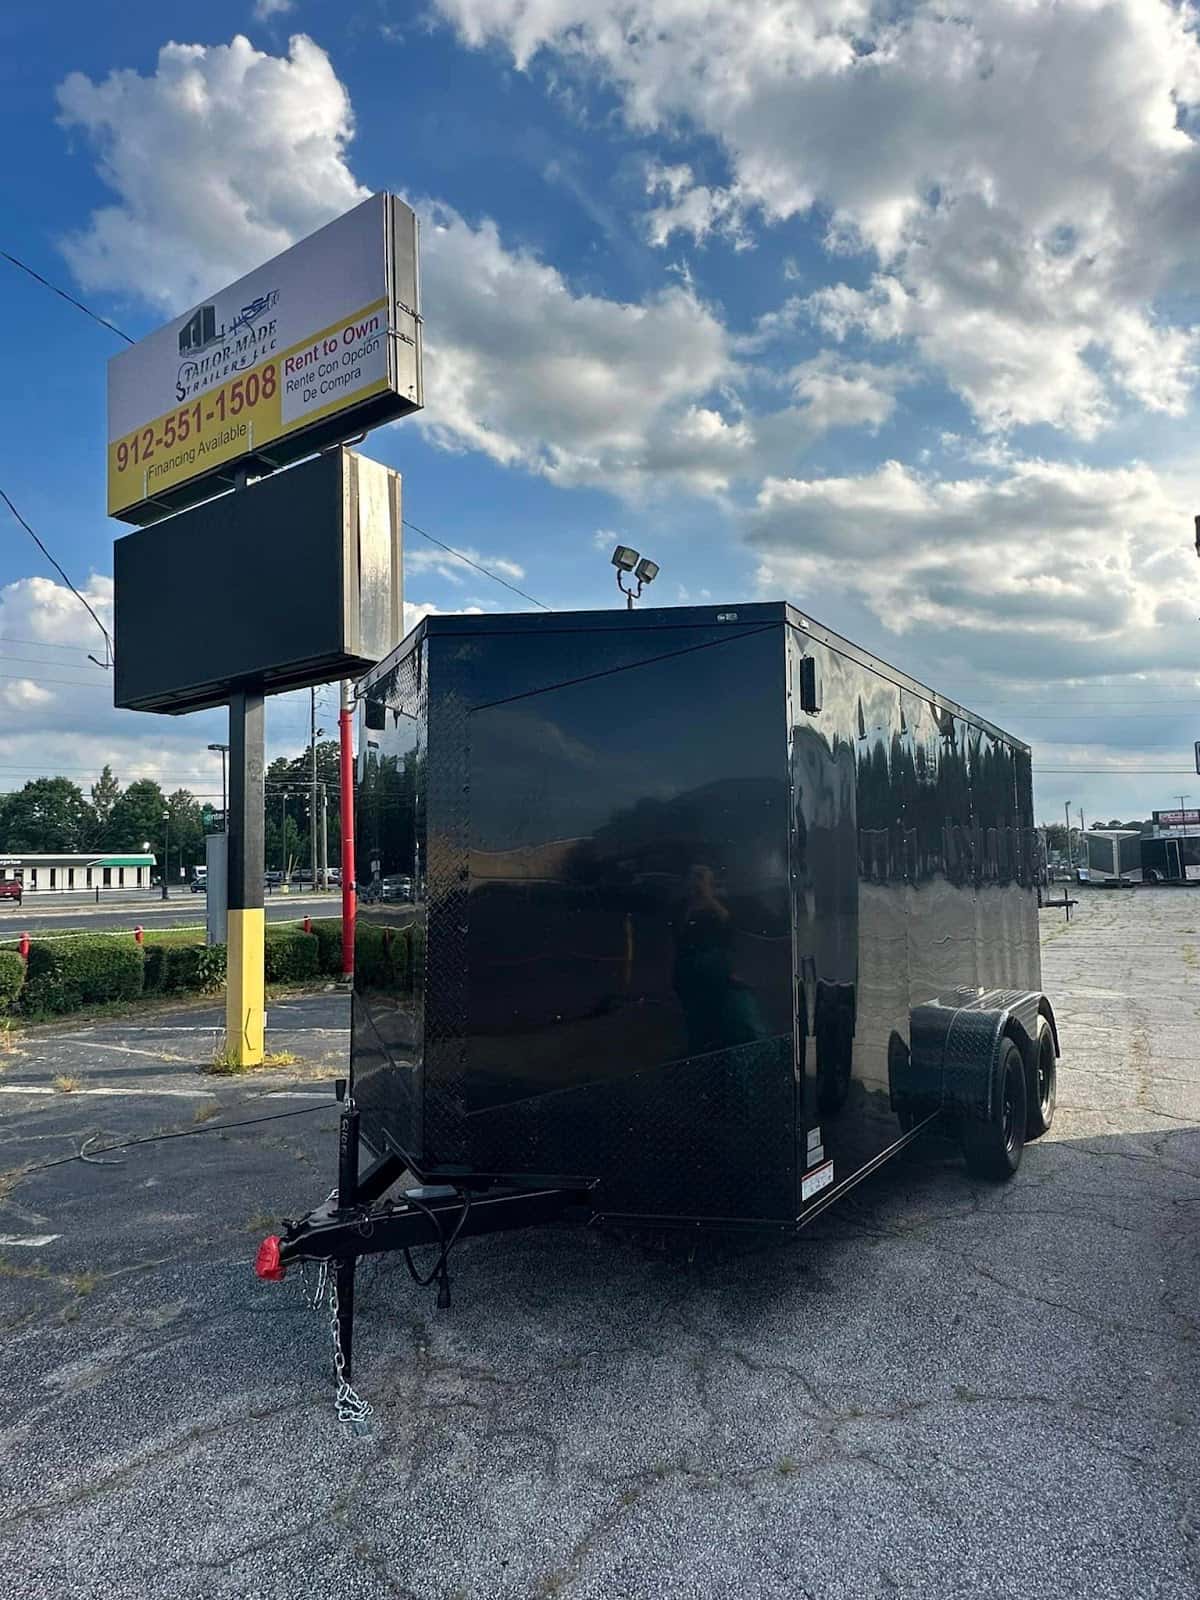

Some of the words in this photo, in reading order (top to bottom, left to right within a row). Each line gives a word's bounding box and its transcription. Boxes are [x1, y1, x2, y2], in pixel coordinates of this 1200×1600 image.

[185, 319, 277, 381] TAILOR-MADE
[284, 345, 320, 376] Rent
[323, 338, 338, 356] to
[343, 316, 379, 345] Own
[286, 371, 316, 394] Rente
[318, 360, 339, 377] Con
[303, 388, 318, 403] De
[320, 367, 361, 394] Compra
[116, 363, 277, 473] 912-551-1508
[148, 447, 196, 480] Financing
[199, 422, 247, 456] Available
